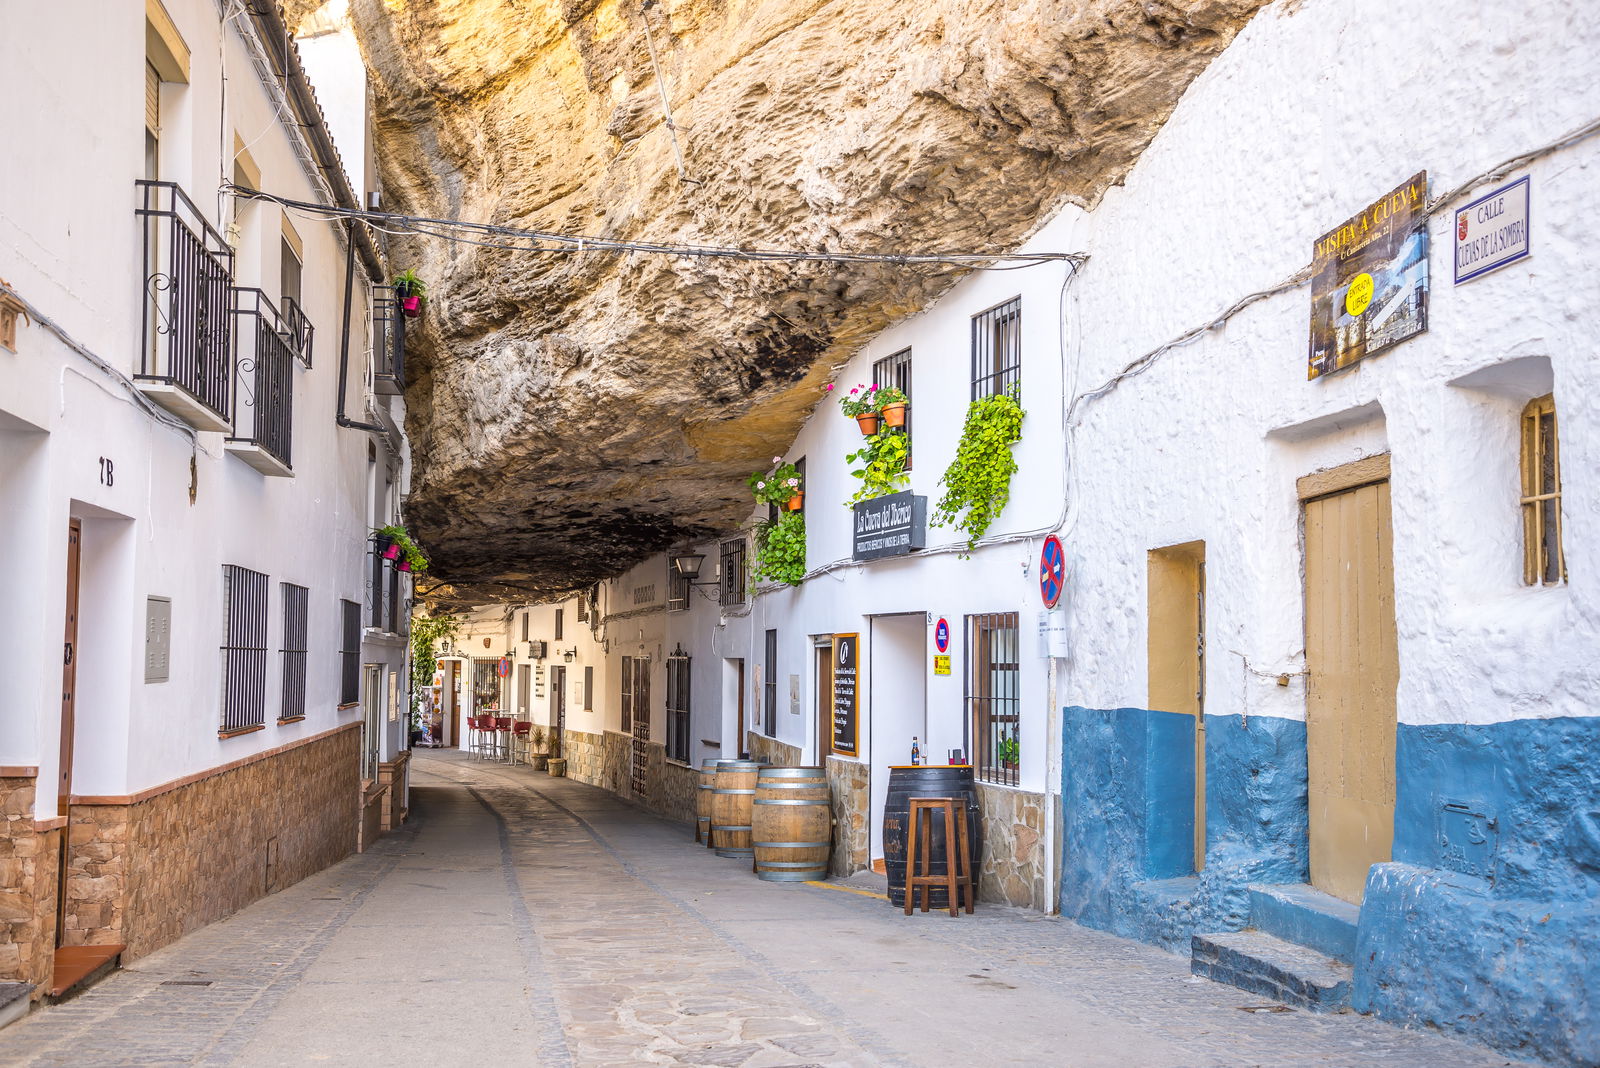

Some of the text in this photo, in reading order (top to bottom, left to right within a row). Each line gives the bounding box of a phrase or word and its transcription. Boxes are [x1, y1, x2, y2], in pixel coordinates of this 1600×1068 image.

[1317, 184, 1418, 257] VISITA A CUEVA
[1477, 197, 1505, 224] CALLE
[1458, 219, 1525, 268] CUEVAS DE LA SOMBRA
[1349, 278, 1371, 298] ENTRADA
[1352, 292, 1368, 311] LIBRE
[857, 511, 864, 533] La
[865, 509, 880, 532] Cueva
[881, 504, 890, 528] del
[928, 612, 932, 623] 8
